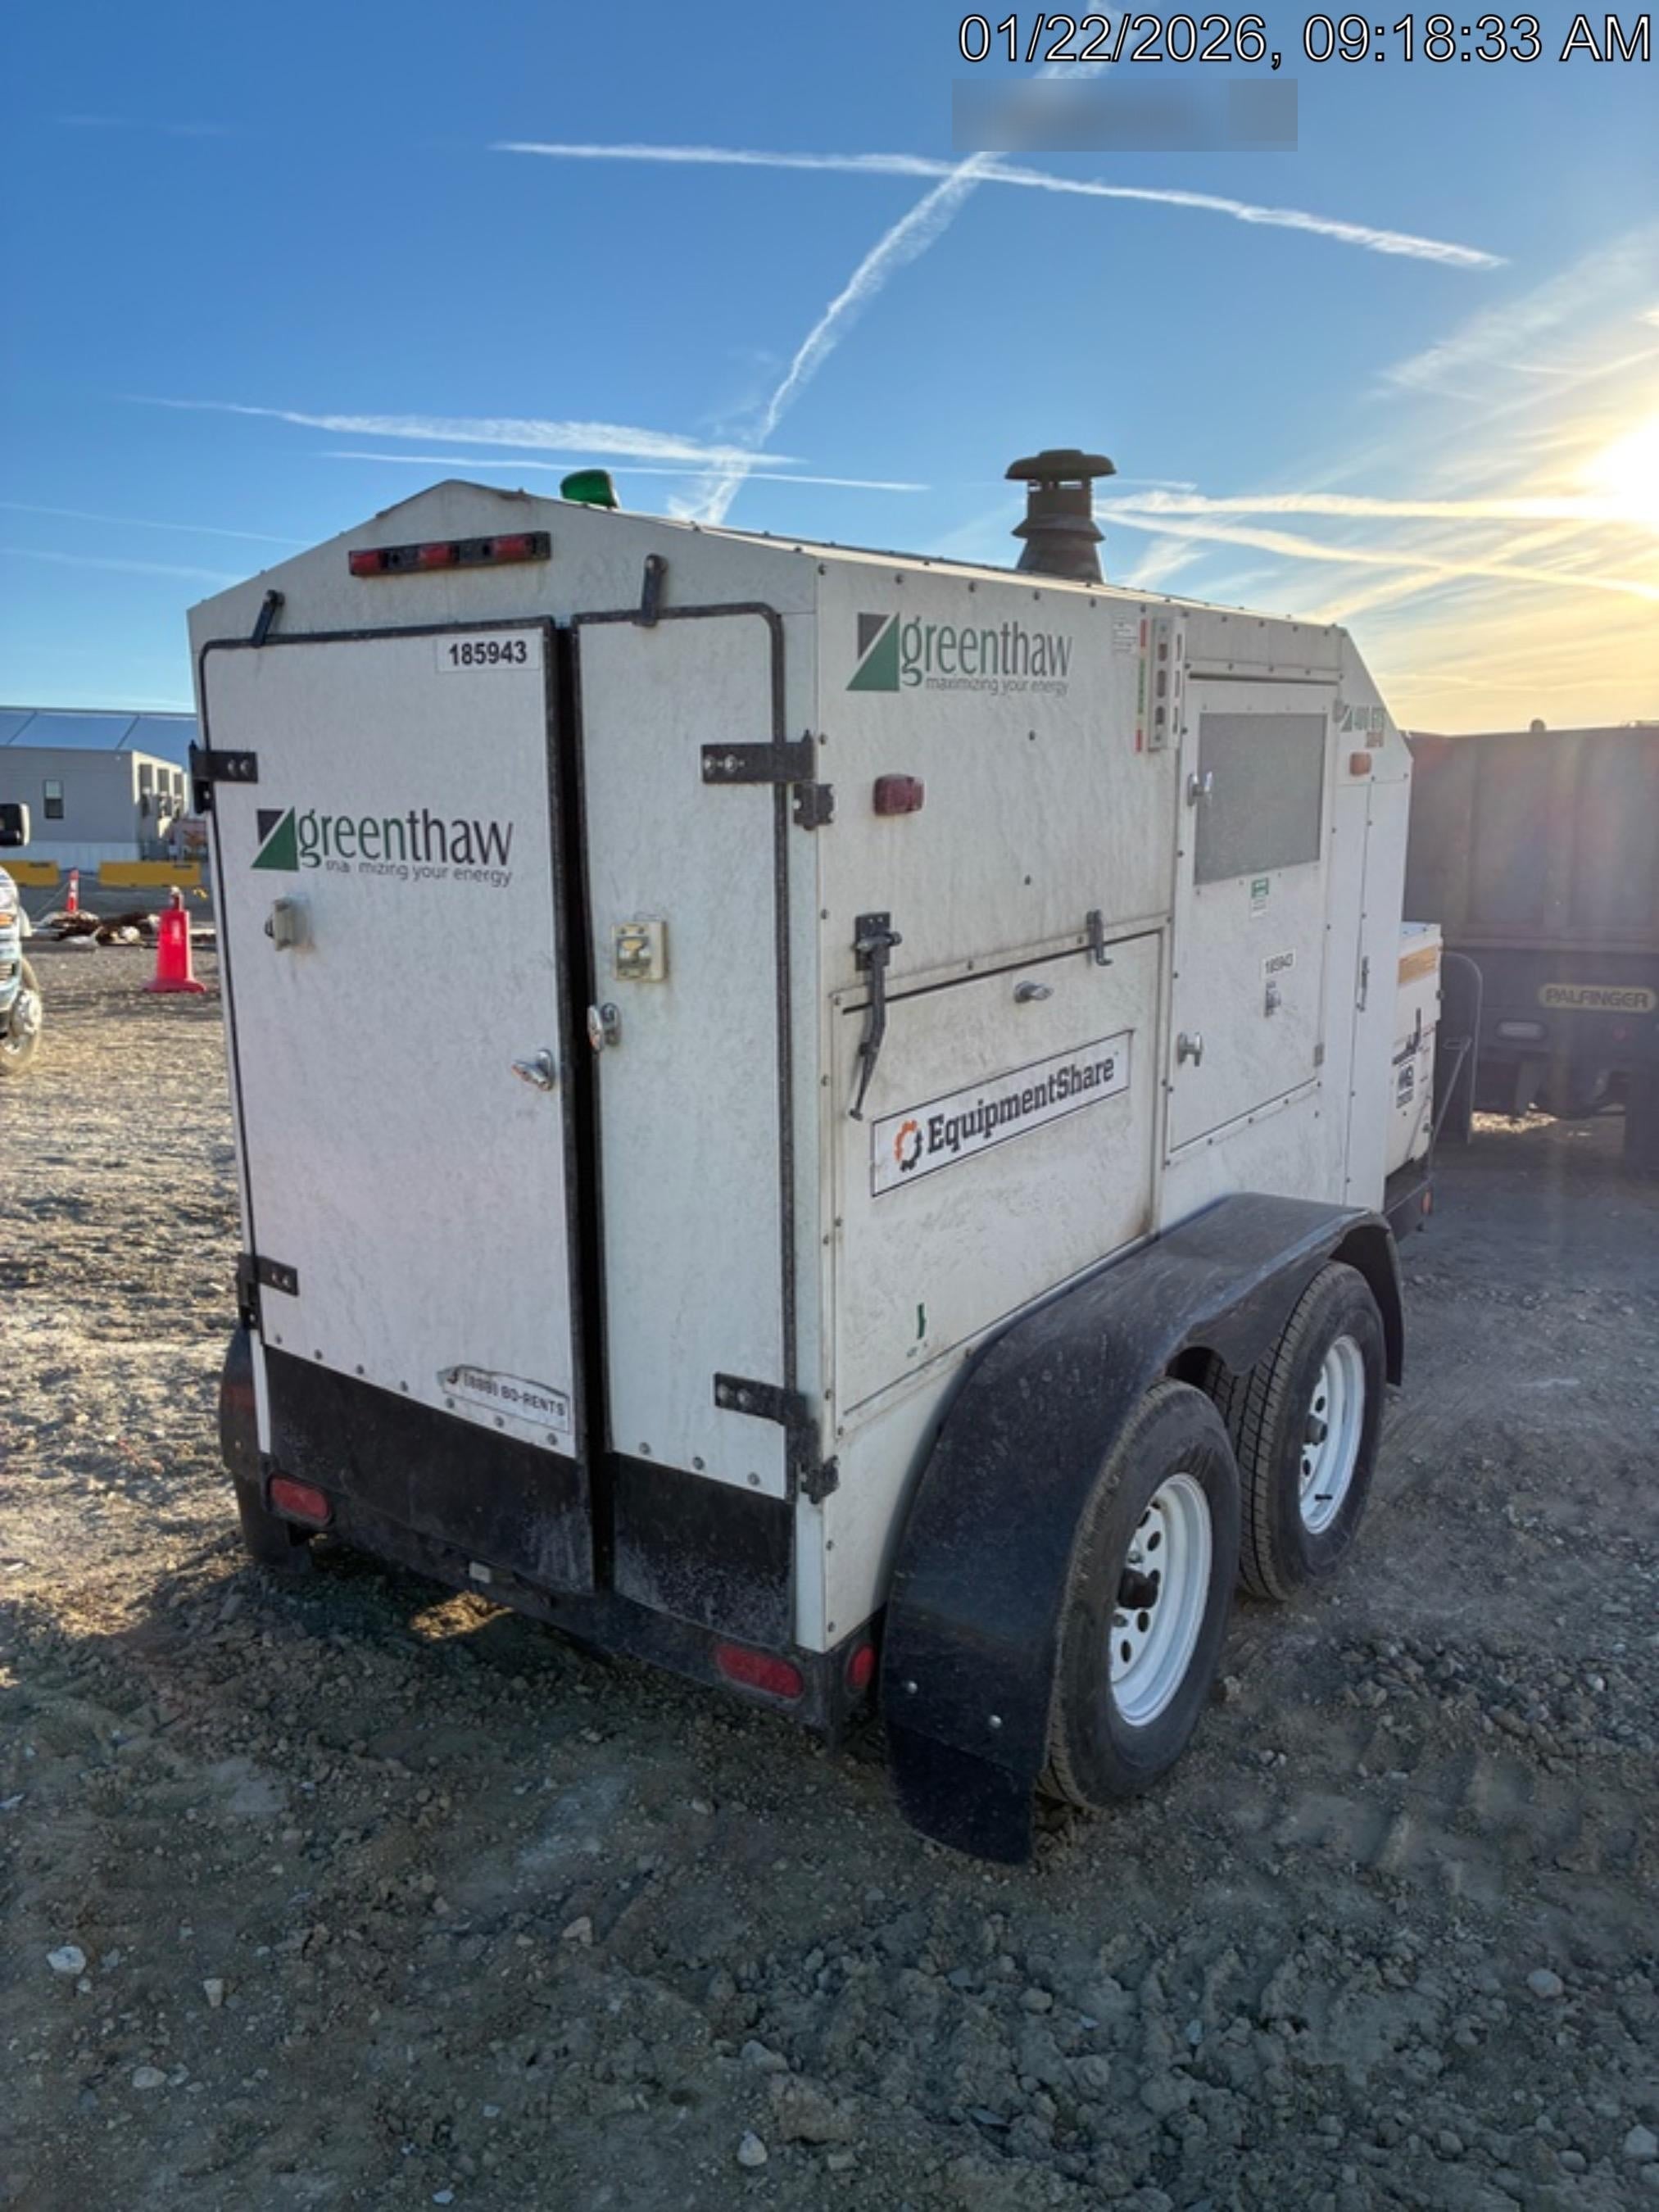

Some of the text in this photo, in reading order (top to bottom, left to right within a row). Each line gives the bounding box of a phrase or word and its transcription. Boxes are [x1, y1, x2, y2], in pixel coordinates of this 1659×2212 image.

[448, 639, 527, 666] 185943
[901, 616, 1073, 687] greenthaw
[926, 678, 1068, 696] maximizing your energy
[297, 808, 514, 868] greenthaw
[412, 864, 449, 882] your
[453, 867, 513, 888] energy
[1545, 986, 1648, 1009] PALFINGER
[927, 1058, 1115, 1154] EquipmentShare
